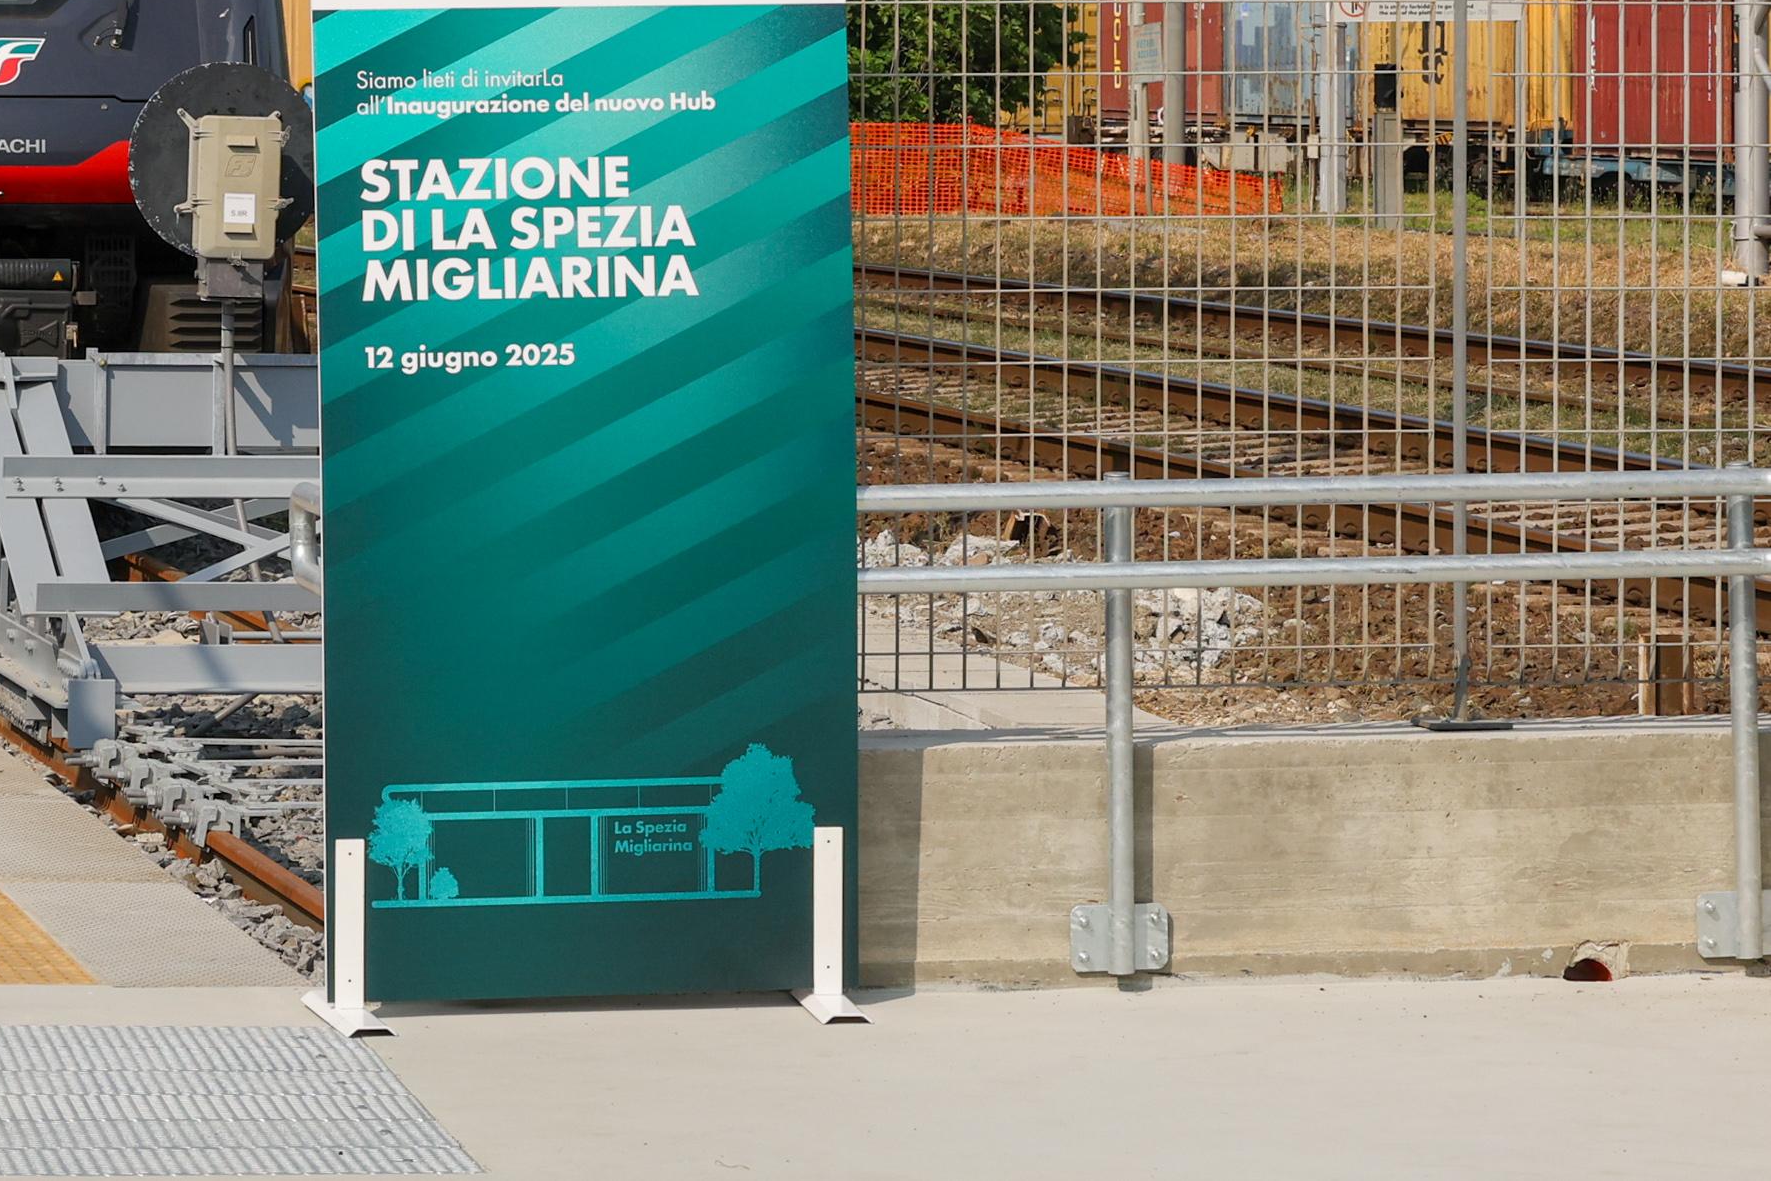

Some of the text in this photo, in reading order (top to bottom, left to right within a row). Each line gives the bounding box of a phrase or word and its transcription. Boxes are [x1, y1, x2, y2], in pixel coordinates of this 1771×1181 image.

[356, 68, 563, 89] Siamo lieti di invitarLa
[555, 92, 589, 112] del
[594, 96, 665, 112] nuovo
[670, 90, 716, 111] Hub
[360, 156, 629, 202] STAZIONE
[362, 205, 696, 251] DI LA SPEZIA
[362, 255, 700, 301] MIGLIARINA
[364, 343, 575, 375] 12 giugno 2025
[614, 819, 687, 837] La Spezia
[614, 838, 693, 856] Migliarina
